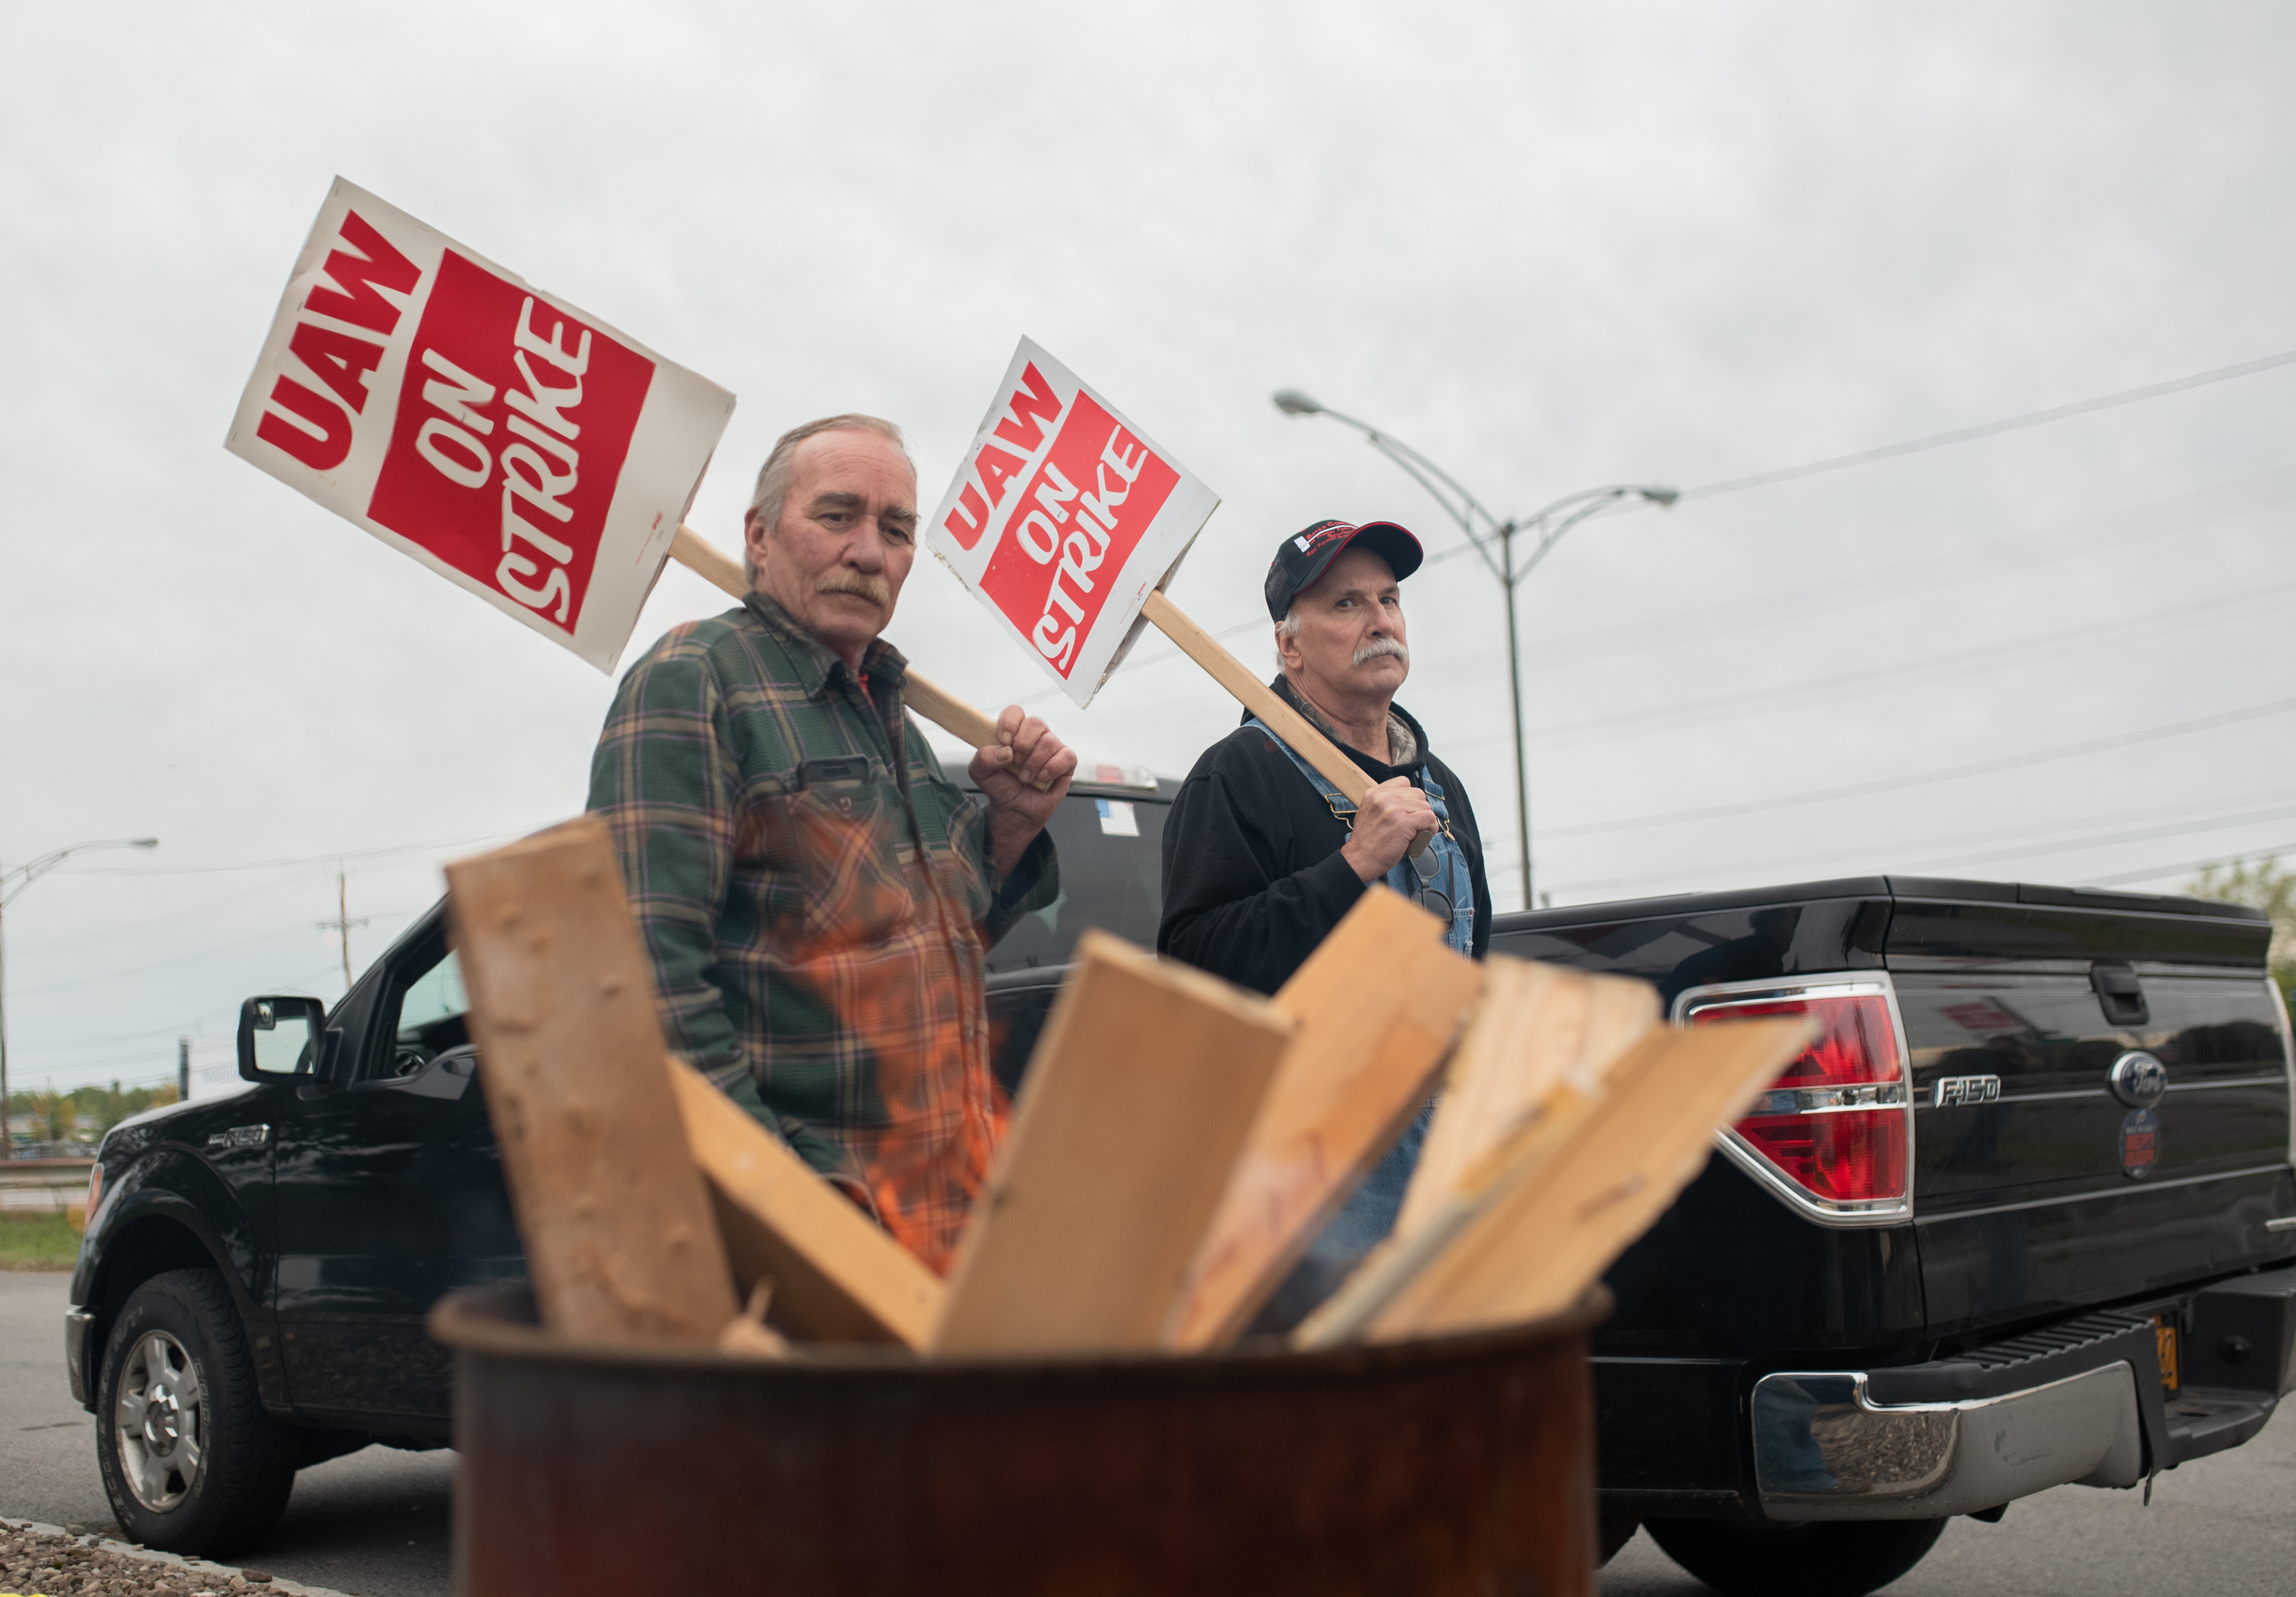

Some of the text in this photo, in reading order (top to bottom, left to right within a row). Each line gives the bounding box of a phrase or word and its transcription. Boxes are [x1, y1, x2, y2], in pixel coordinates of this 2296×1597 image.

[256, 208, 422, 471] UAW
[415, 347, 497, 489] ON
[495, 296, 592, 623] STRIKE
[944, 360, 1063, 551] UAW
[1017, 461, 1080, 565] ON
[1032, 424, 1149, 670] STRIKE
